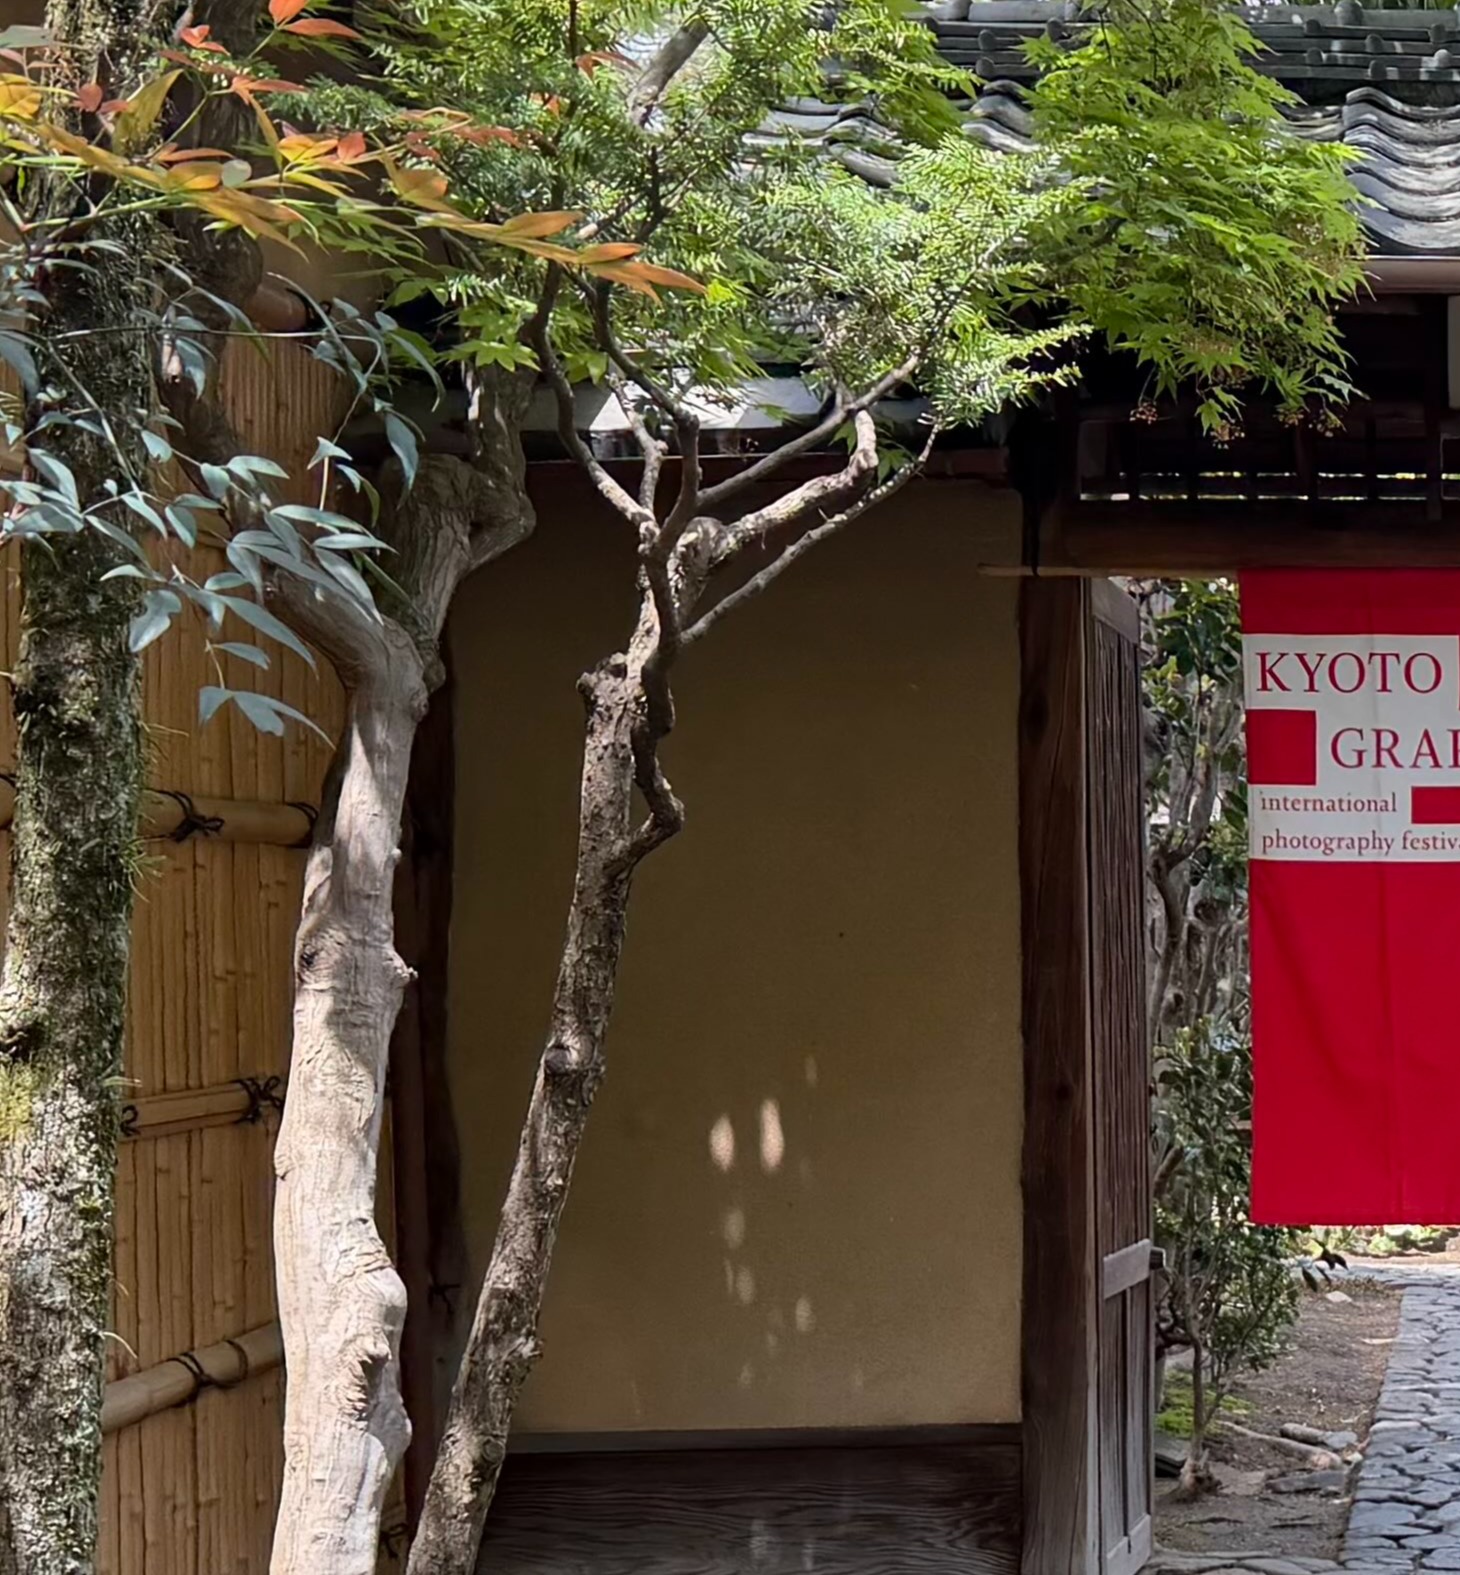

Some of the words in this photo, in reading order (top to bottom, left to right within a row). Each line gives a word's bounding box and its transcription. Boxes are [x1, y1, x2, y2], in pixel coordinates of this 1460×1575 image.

[1255, 651, 1443, 694] KYOTO
[1259, 791, 1398, 813] international
[1261, 829, 1395, 857] photography
